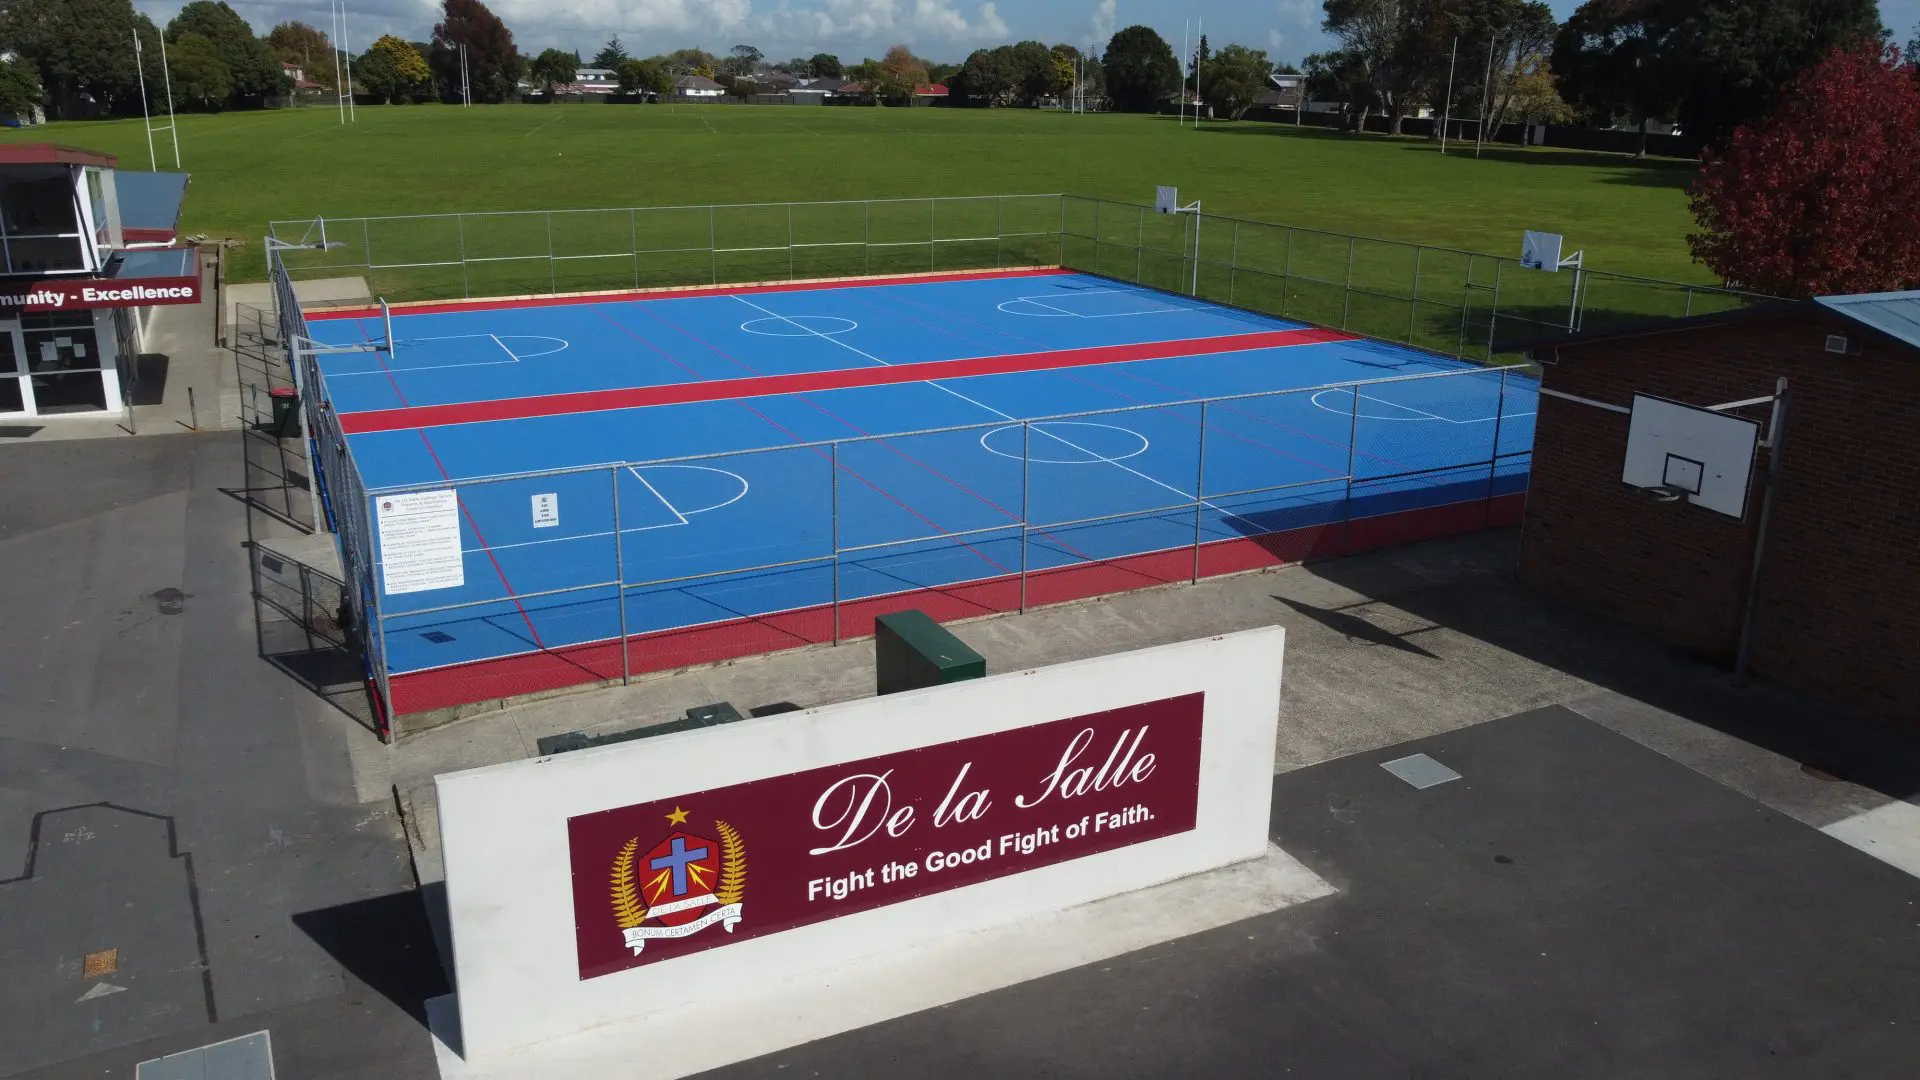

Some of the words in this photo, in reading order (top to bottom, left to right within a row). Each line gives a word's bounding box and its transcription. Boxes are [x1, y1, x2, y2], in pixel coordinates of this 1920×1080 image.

[82, 286, 193, 302] Excellence
[809, 768, 915, 856] De
[933, 762, 992, 827] la
[1015, 725, 1157, 808] Salle
[809, 868, 874, 901] Fight
[882, 862, 918, 883] the
[926, 840, 991, 872] Good
[1000, 825, 1059, 855] Fight
[1066, 816, 1089, 838] of
[1095, 804, 1154, 832] Faith.
[652, 906, 666, 914] DE
[669, 902, 681, 911] LA
[683, 896, 711, 908] SALLE
[632, 929, 663, 939] BONUM
[664, 919, 708, 938] CERTAMEN
[710, 906, 736, 922] CERTA
